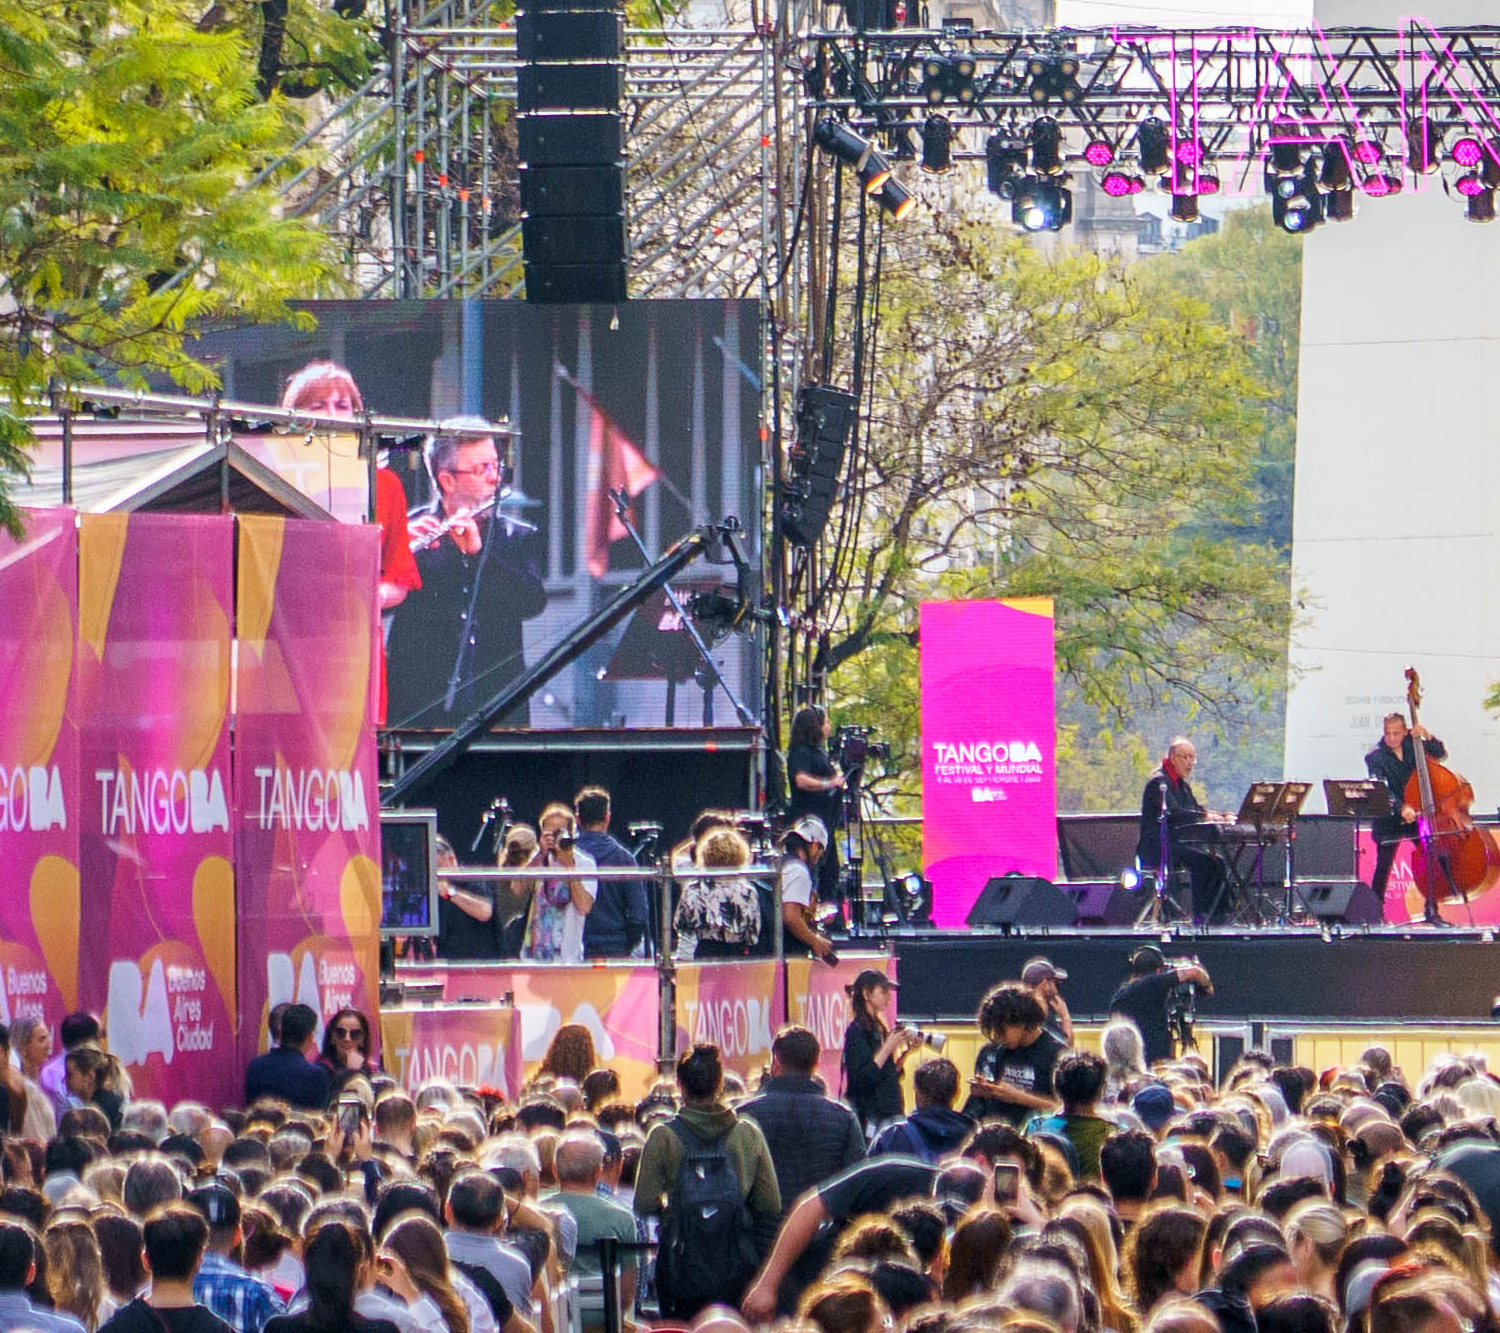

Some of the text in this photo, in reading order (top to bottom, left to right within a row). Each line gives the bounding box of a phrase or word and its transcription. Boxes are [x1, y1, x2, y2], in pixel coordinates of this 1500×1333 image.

[932, 740, 1043, 763] TANGOBA
[934, 763, 1043, 776] FESTIVAL Y MUNDIAL
[95, 766, 230, 834] TANGOBA
[254, 766, 370, 833] TANGOBA
[7, 965, 48, 995] Buenos
[318, 960, 356, 986] Buenos
[173, 996, 202, 1022] Aires
[176, 1020, 214, 1052] Ciudad
[684, 997, 771, 1056] TANGOBA
